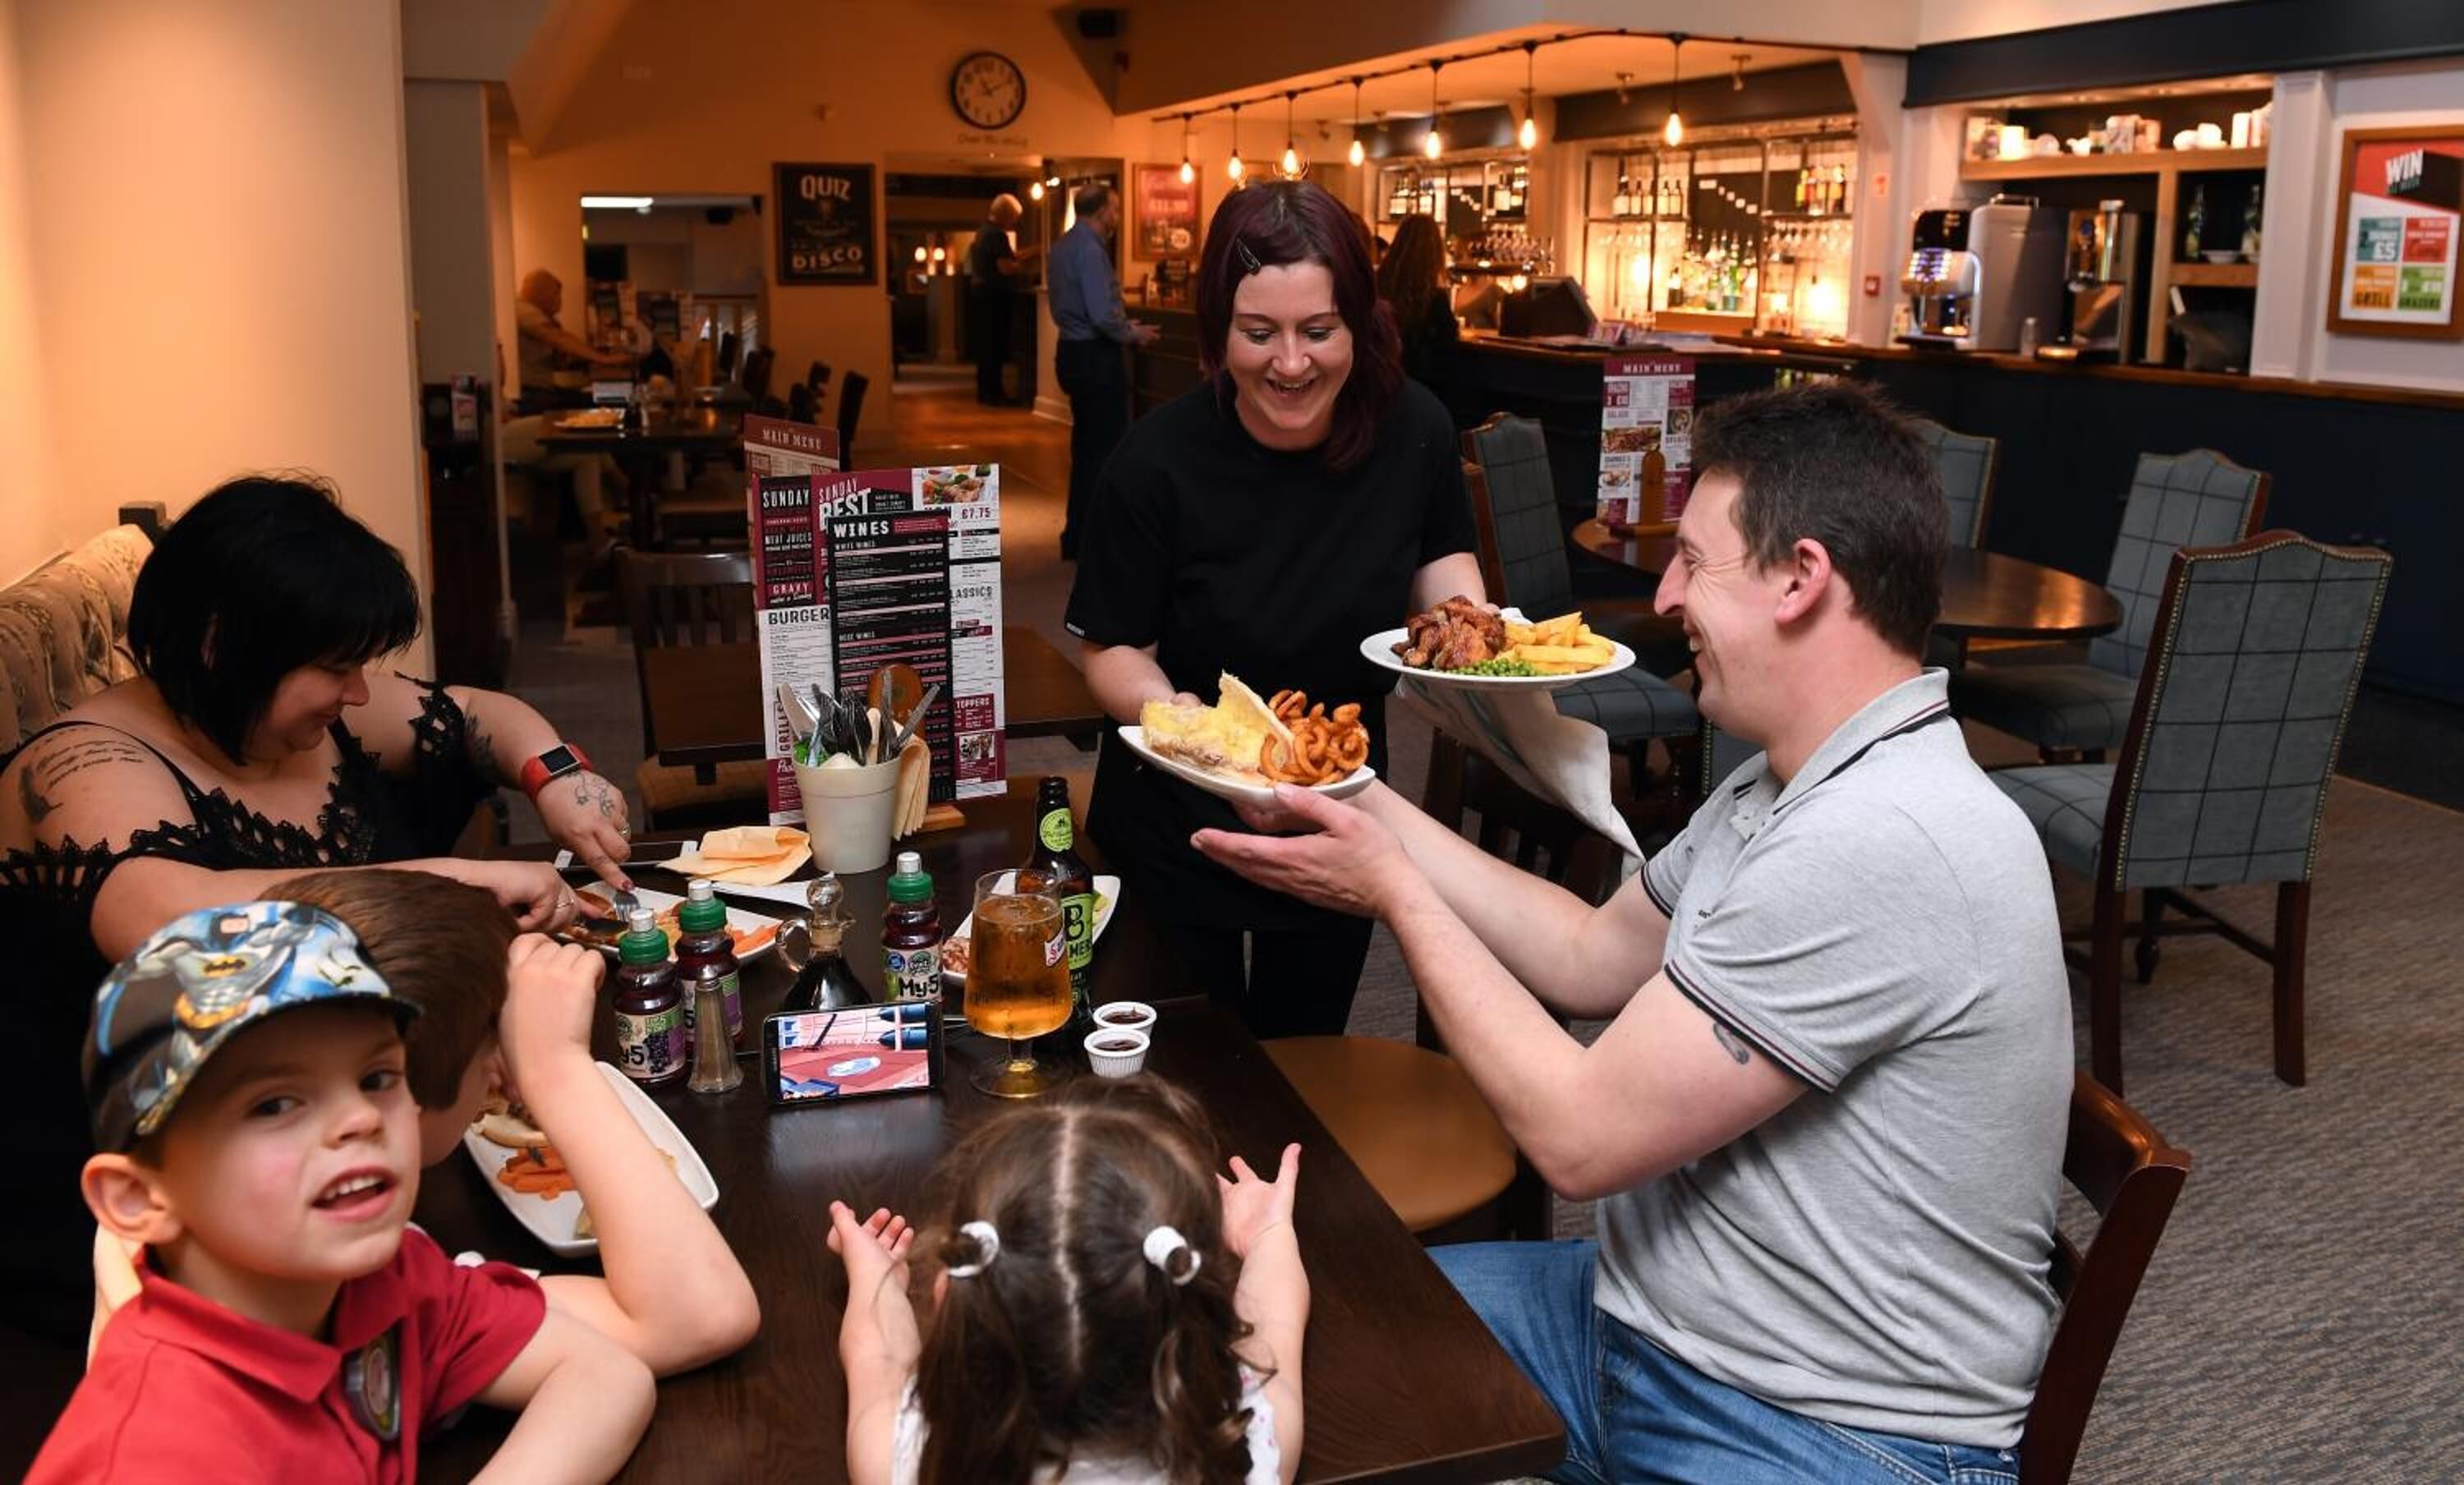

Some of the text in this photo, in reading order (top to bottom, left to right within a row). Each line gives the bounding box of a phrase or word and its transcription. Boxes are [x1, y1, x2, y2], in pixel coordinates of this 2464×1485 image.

[2384, 148, 2424, 185] WIN
[800, 174, 852, 201] QUIZ
[792, 246, 862, 270] DISCO
[1623, 364, 1681, 374] MAIN MENU
[762, 427, 821, 450] MAIN MENU
[762, 488, 810, 508] SUNDAY
[819, 477, 857, 503] SUNDAY
[819, 488, 871, 531] BEST
[962, 507, 991, 520] £7.75
[834, 521, 890, 538] WINES
[773, 582, 808, 595] GRAVY
[768, 608, 830, 625] BURGER
[956, 697, 990, 709] TOPPERS
[1064, 904, 1084, 940] B
